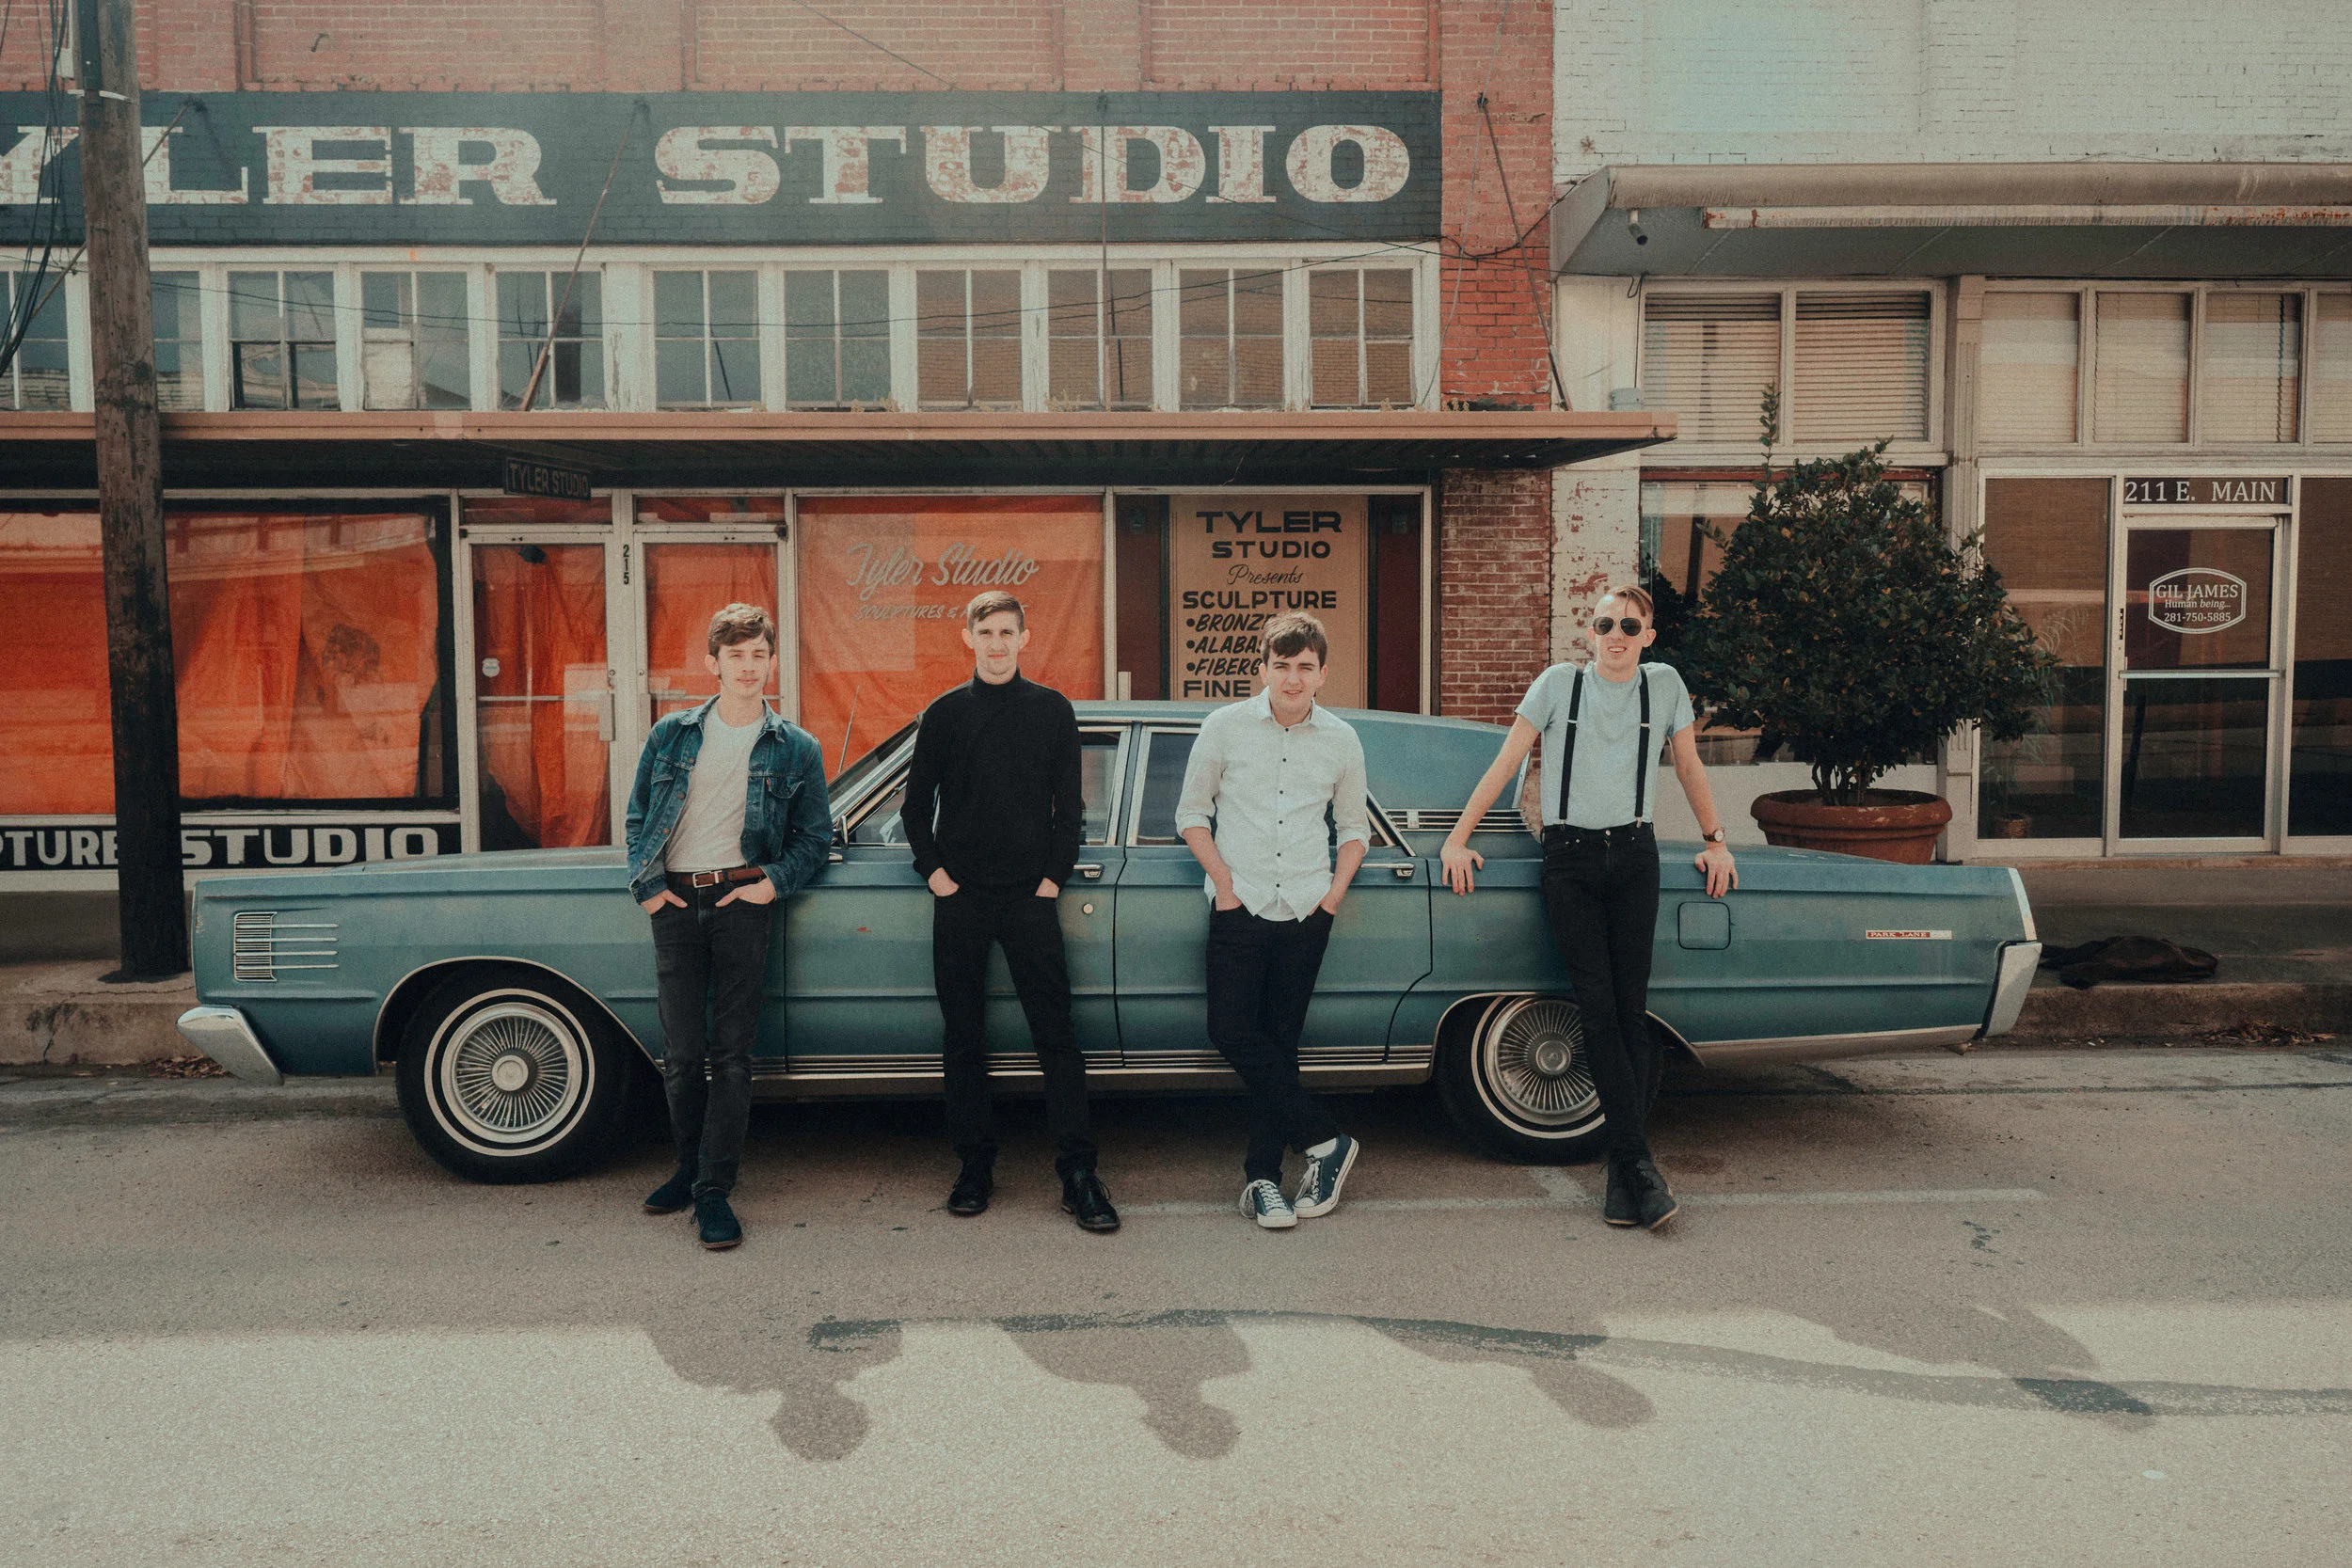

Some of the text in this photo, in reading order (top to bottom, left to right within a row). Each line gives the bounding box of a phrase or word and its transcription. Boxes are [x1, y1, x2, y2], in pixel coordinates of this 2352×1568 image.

[654, 125, 1410, 205] STUDIO
[510, 463, 589, 497] TYLER STUDIO
[2124, 481, 2277, 502] 211 E. MAIN
[1197, 511, 1343, 533] TYLER
[1212, 541, 1331, 559] STUDIO
[847, 542, 1040, 601] Tyler Studio
[1227, 564, 1304, 585] Presents
[1183, 591, 1337, 610] SCULPTURE
[2155, 584, 2239, 601] GIL JAMES
[854, 604, 942, 620] SCULPTURES
[2165, 599, 2198, 609] Human
[2164, 612, 2232, 622] 281-750-5885
[1184, 680, 1251, 697] FINE
[0, 827, 438, 866] TURE STUDIO
